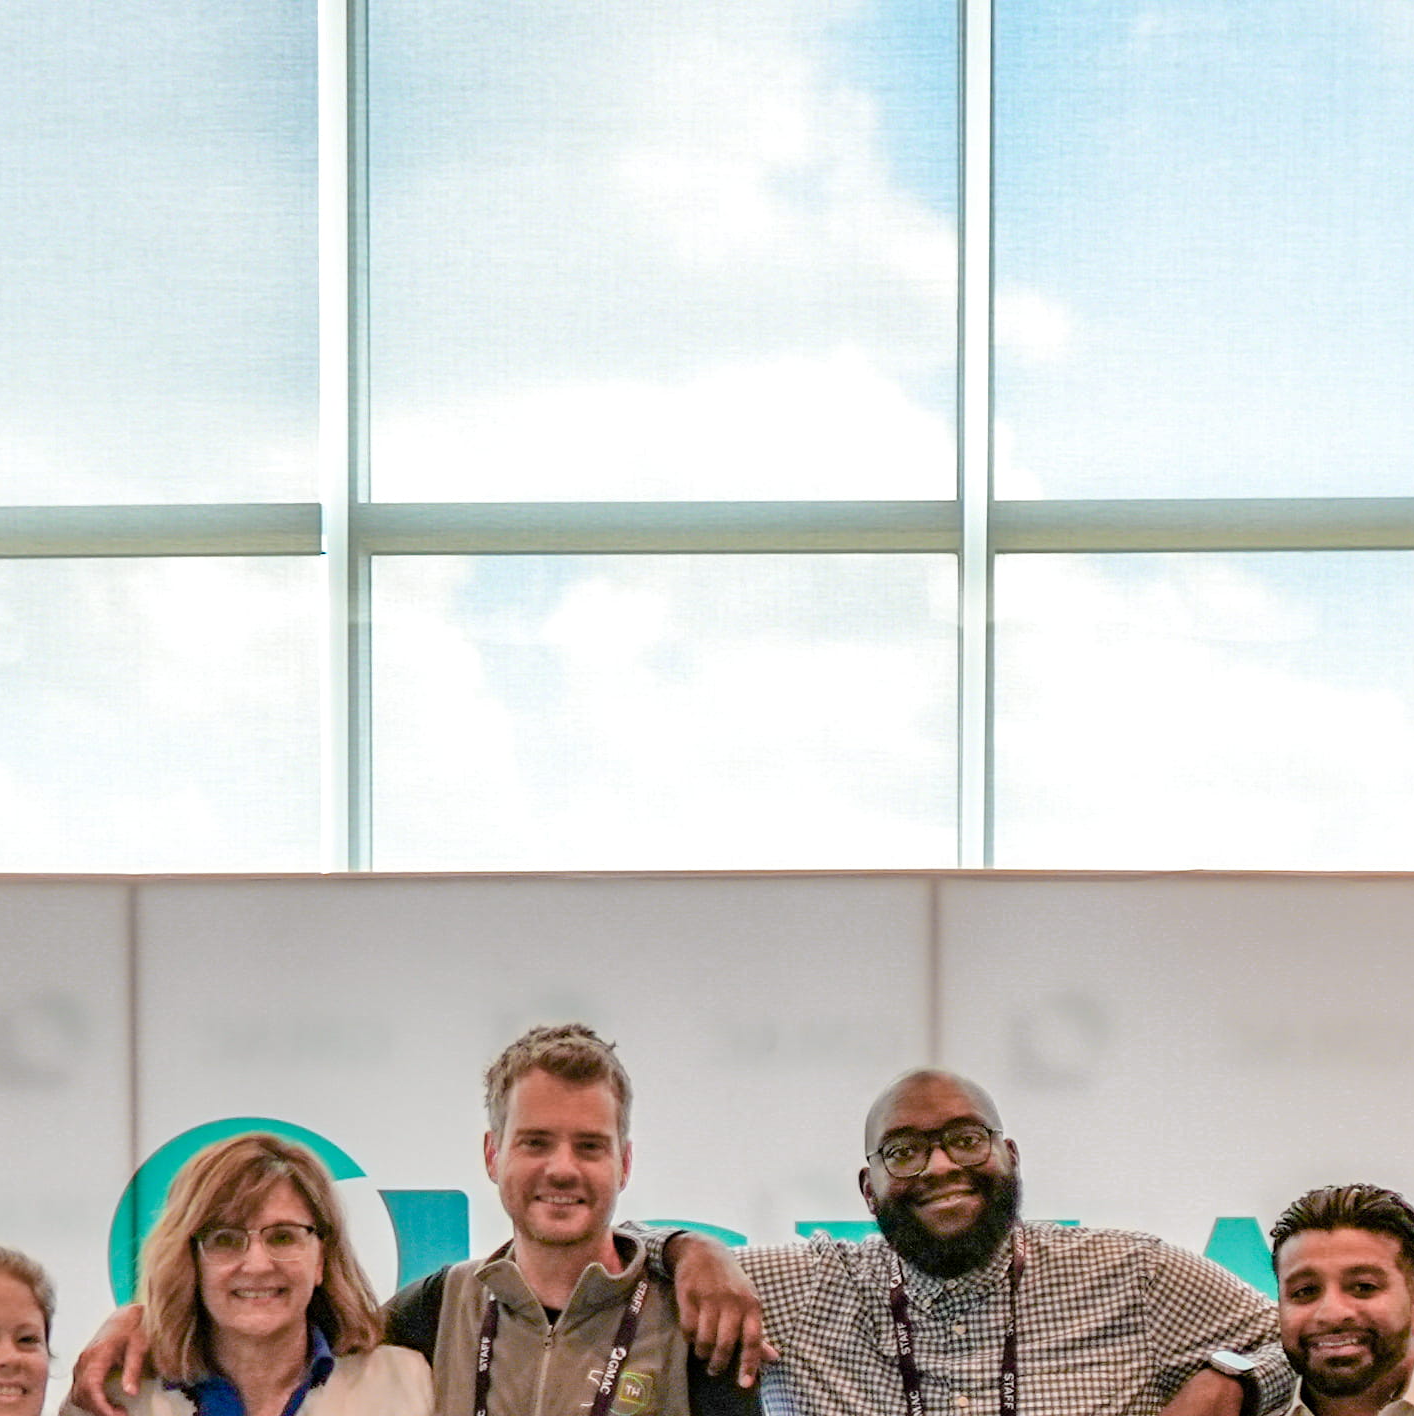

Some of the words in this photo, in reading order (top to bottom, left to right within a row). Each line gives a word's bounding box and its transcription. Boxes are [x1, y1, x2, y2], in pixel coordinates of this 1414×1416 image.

[629, 1280, 649, 1314] STAFF
[479, 1337, 491, 1372] STAFF
[898, 1322, 912, 1355] STAFF
[600, 1360, 619, 1395] GMAC
[1003, 1373, 1015, 1410] STAFF
